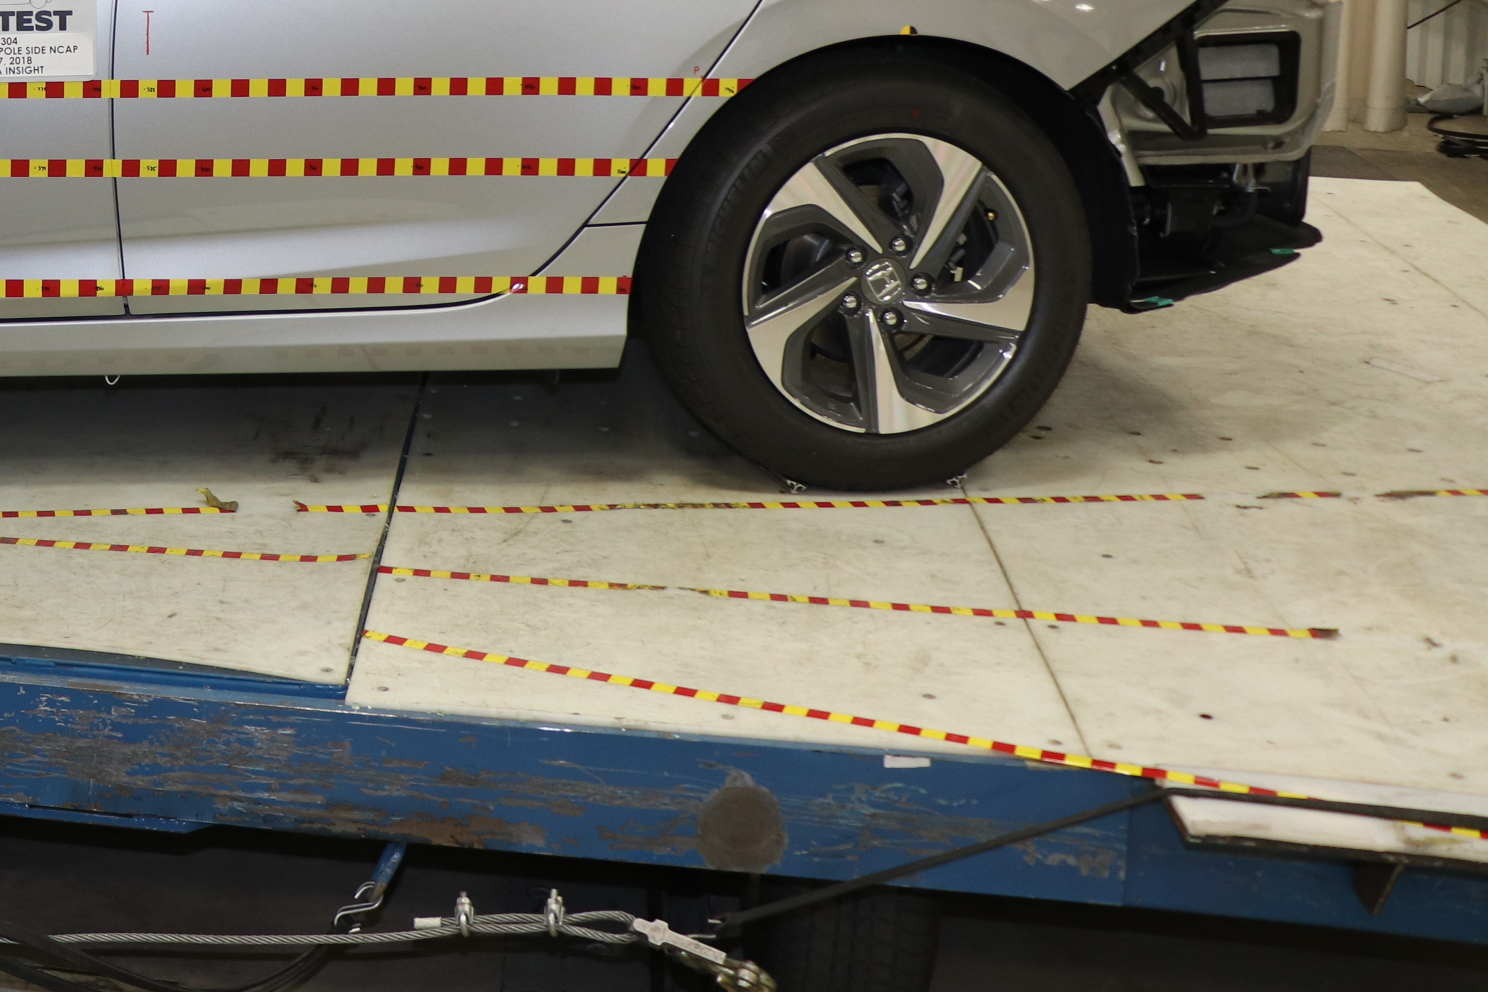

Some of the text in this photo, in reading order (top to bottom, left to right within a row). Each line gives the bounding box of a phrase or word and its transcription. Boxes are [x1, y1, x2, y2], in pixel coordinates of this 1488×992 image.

[25, 46, 47, 55] SIDE
[49, 45, 79, 55] NCAP
[9, 56, 33, 65] 2018
[5, 66, 45, 75] INSIGHT
